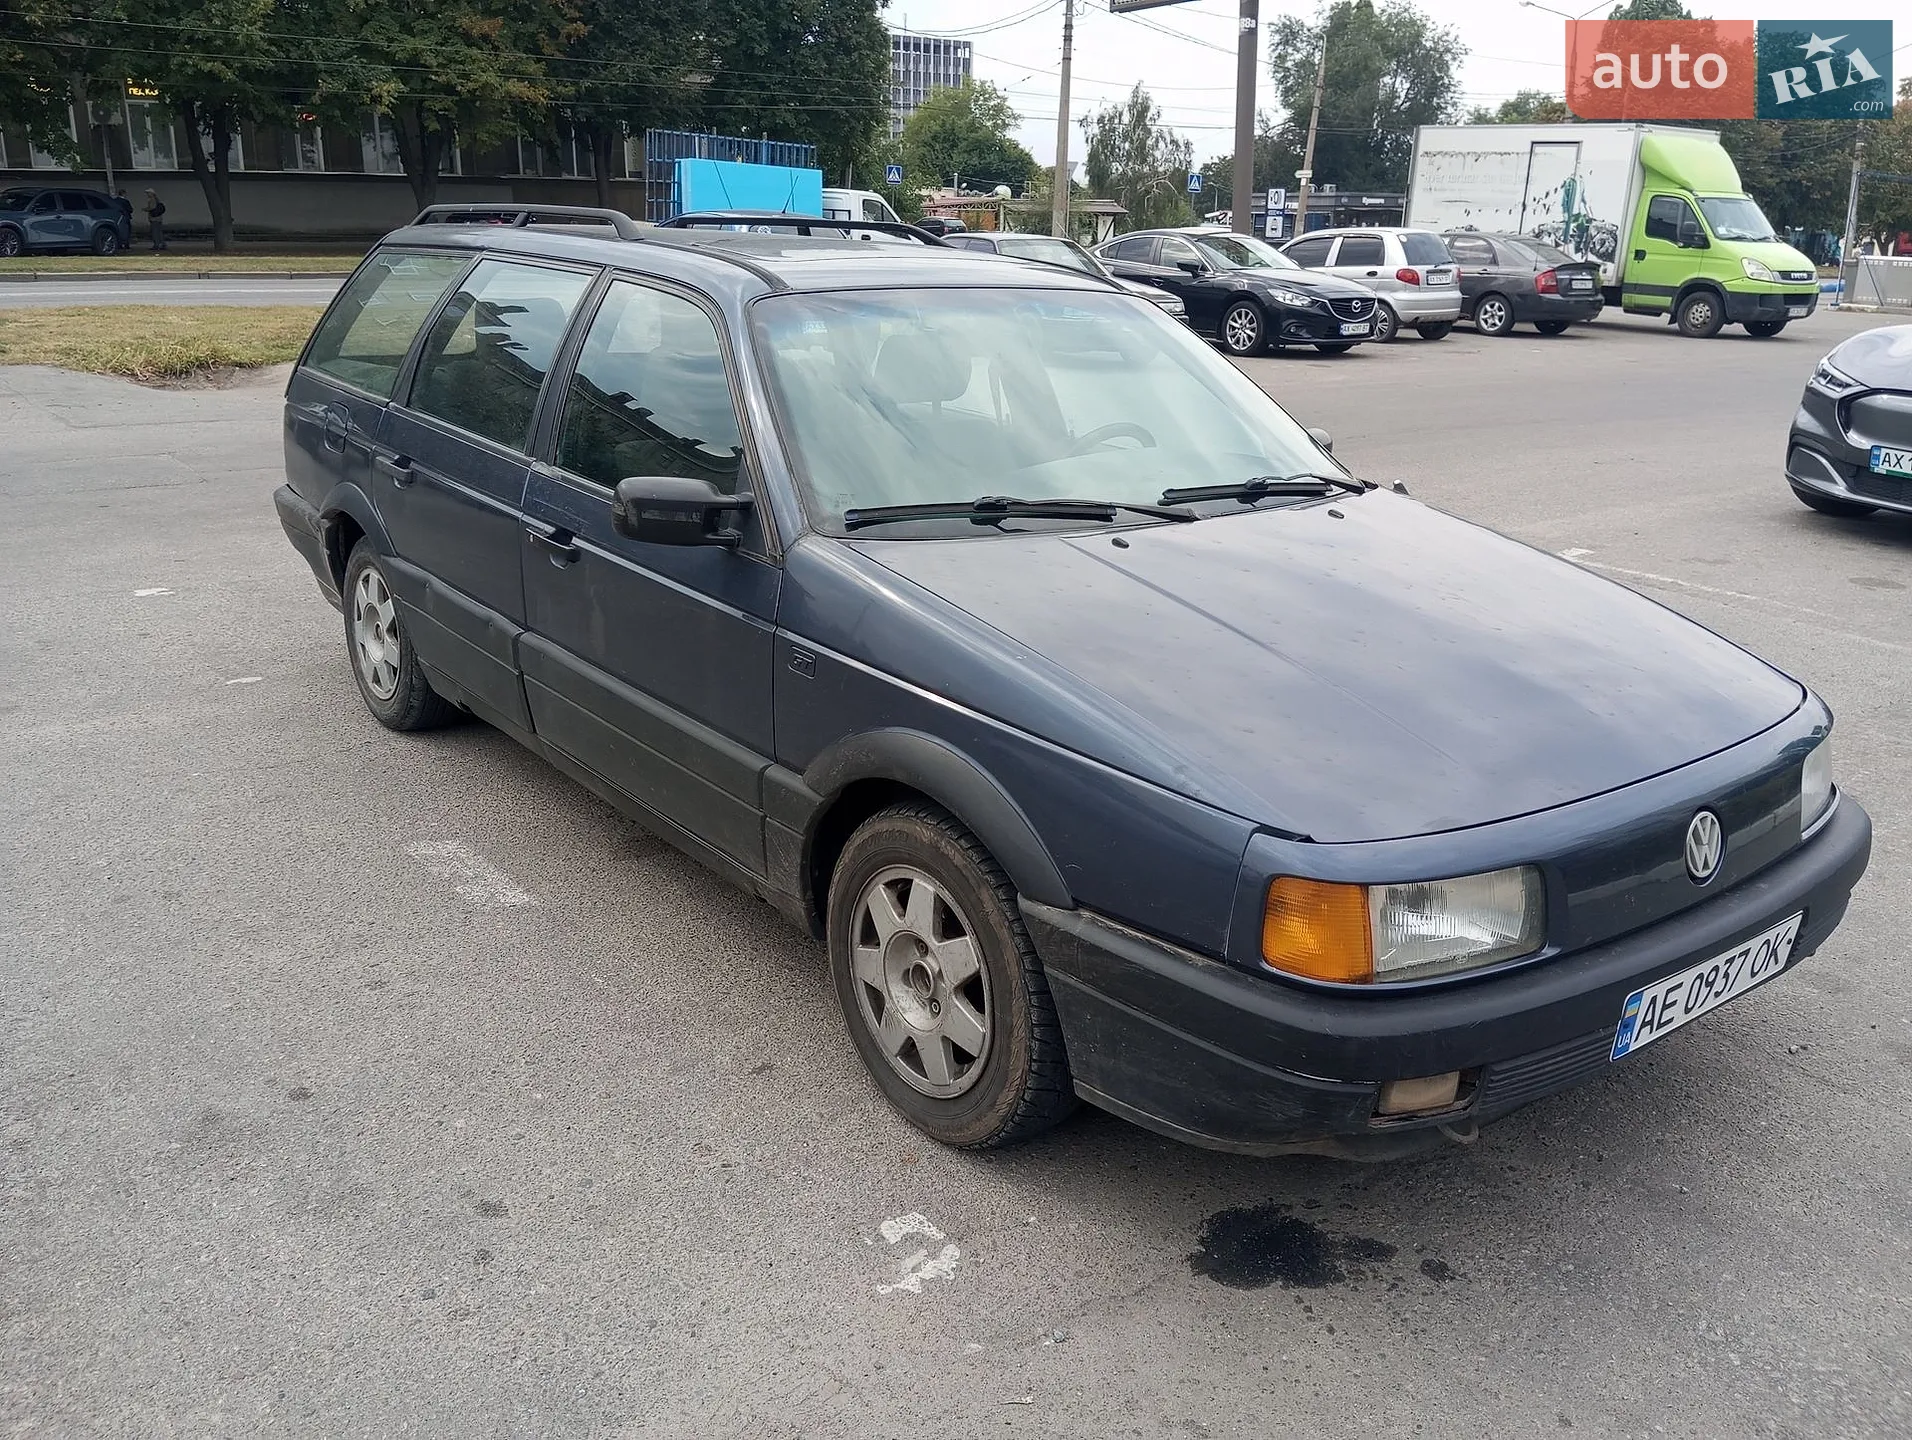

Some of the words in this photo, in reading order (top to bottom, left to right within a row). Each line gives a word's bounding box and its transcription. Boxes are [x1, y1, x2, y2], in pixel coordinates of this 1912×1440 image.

[1881, 452, 1904, 469] AX
[1634, 981, 1684, 1042] AE
[1684, 947, 1751, 1015] 0937
[1750, 926, 1792, 978] OK
[1617, 1033, 1632, 1048] UA
